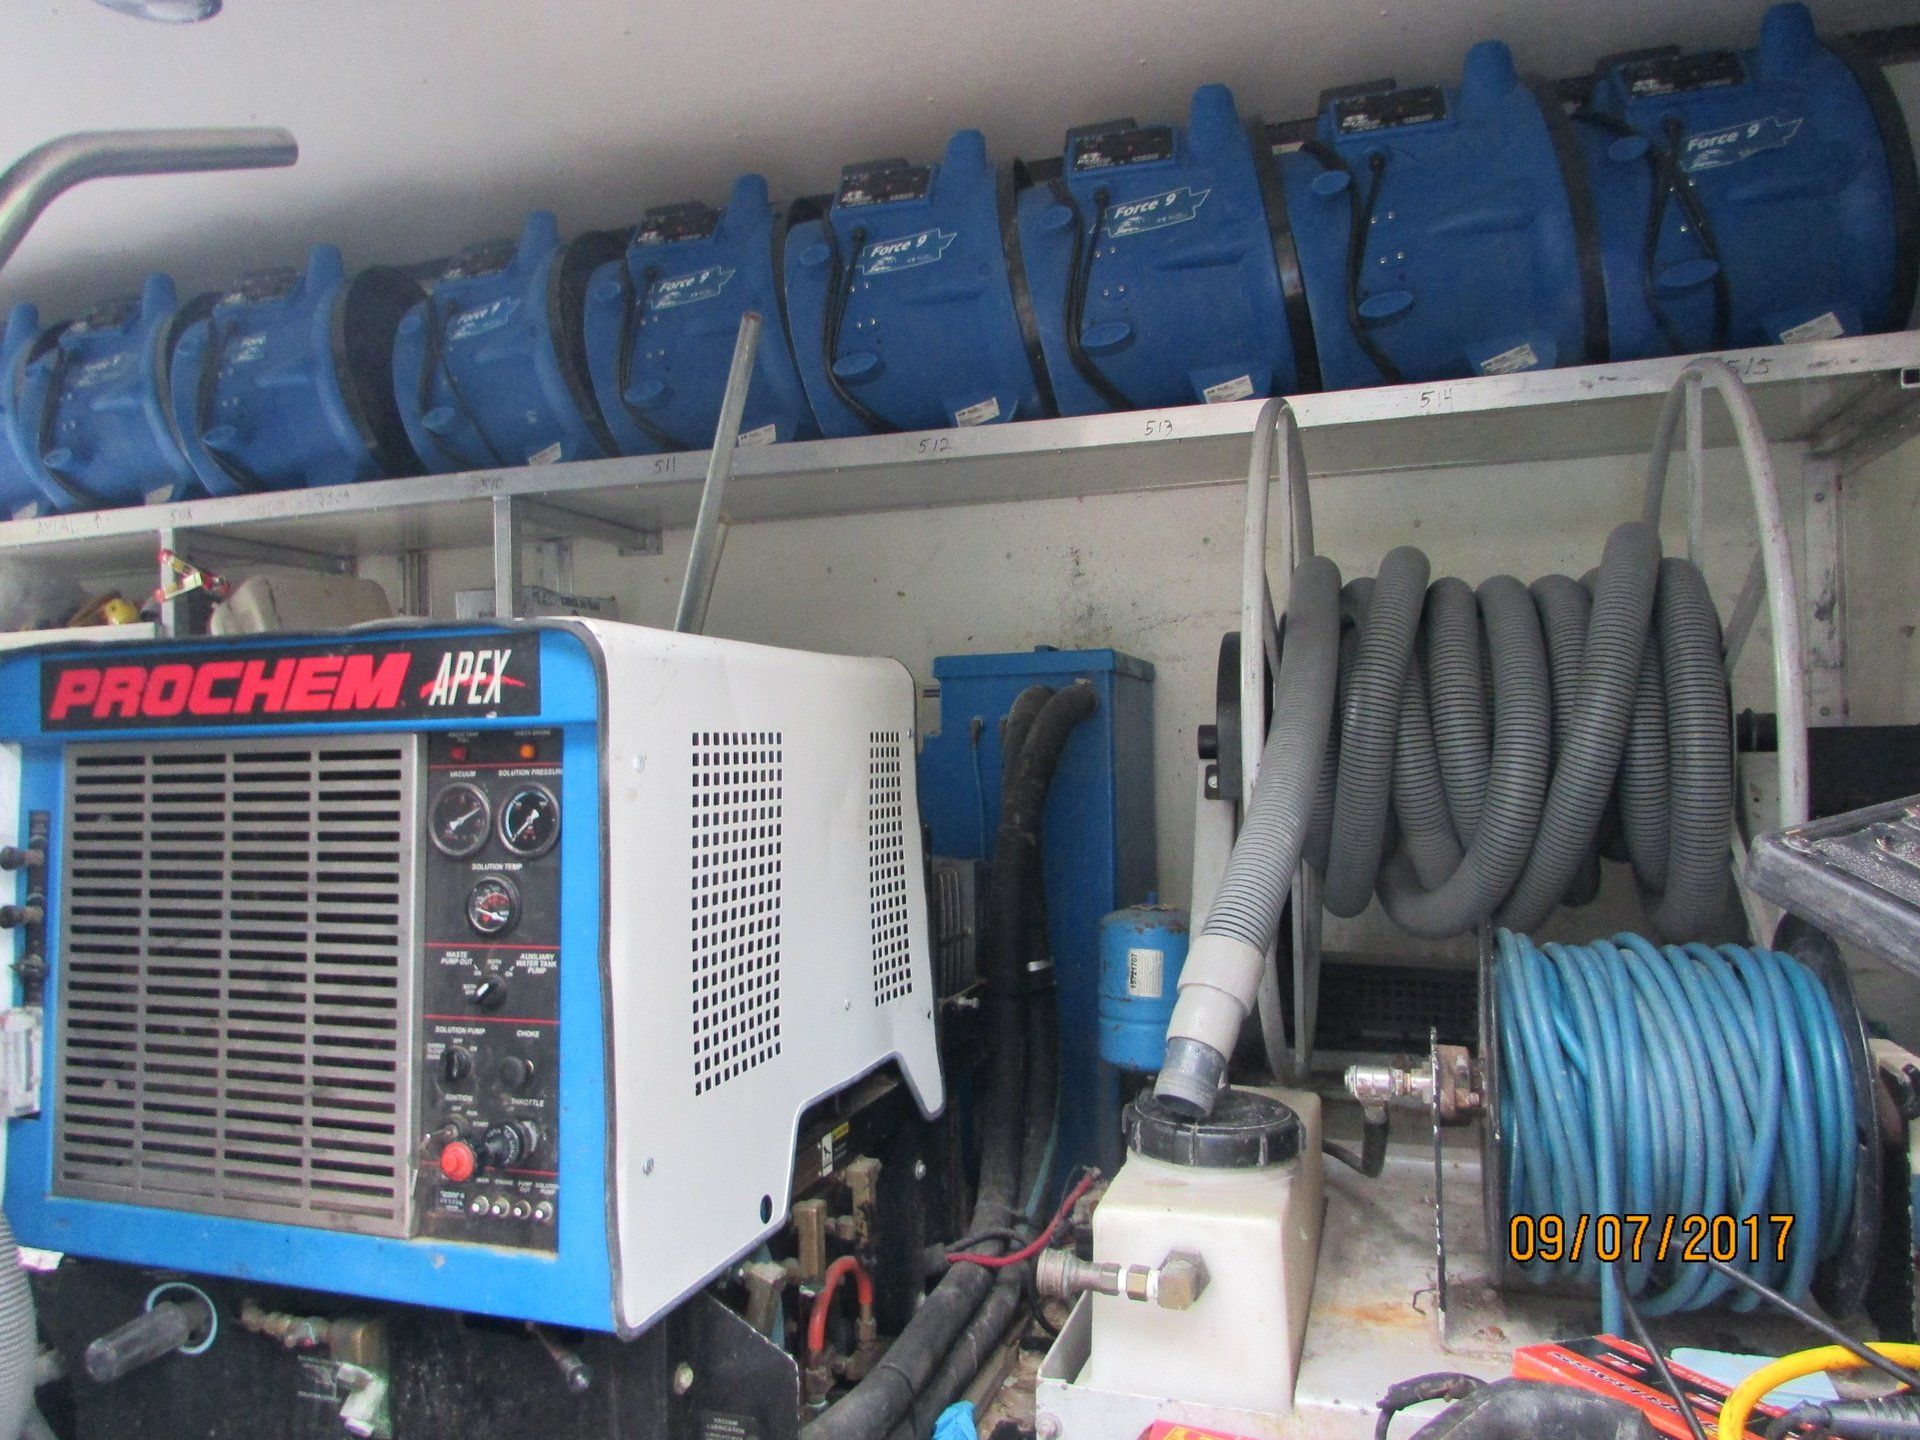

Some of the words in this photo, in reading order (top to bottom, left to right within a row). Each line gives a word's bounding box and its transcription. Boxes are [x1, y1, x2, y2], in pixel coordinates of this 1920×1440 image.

[1687, 131, 1739, 151] Force
[1747, 123, 1760, 138] 9
[1114, 199, 1158, 219] Force
[1165, 193, 1177, 206] 9
[870, 240, 911, 258] Force
[916, 234, 927, 248] 9
[658, 276, 694, 293] Force
[701, 271, 710, 283] 9
[1726, 357, 1774, 375] 515
[1420, 386, 1453, 409] 514
[1144, 419, 1173, 437] 513
[918, 437, 952, 454] 512
[655, 457, 676, 473] 511
[429, 649, 512, 707] APEX
[49, 652, 411, 720] PROCHEM
[450, 770, 477, 778] VACUUM
[498, 769, 530, 777] SOLUTION
[530, 768, 563, 776] PRESSUR
[471, 862, 504, 871] SOLUTION
[504, 862, 522, 871] TEMP
[440, 957, 459, 965] PUMP
[520, 952, 555, 961] AUXILIARY
[540, 960, 557, 968] TANK
[527, 967, 547, 975] PUMP
[435, 1025, 466, 1034] SOLUTION
[467, 1026, 486, 1035] PUMP
[516, 1029, 540, 1038] CHOKE
[445, 1093, 473, 1102] IGNITION
[511, 1097, 544, 1107] THROTTLE
